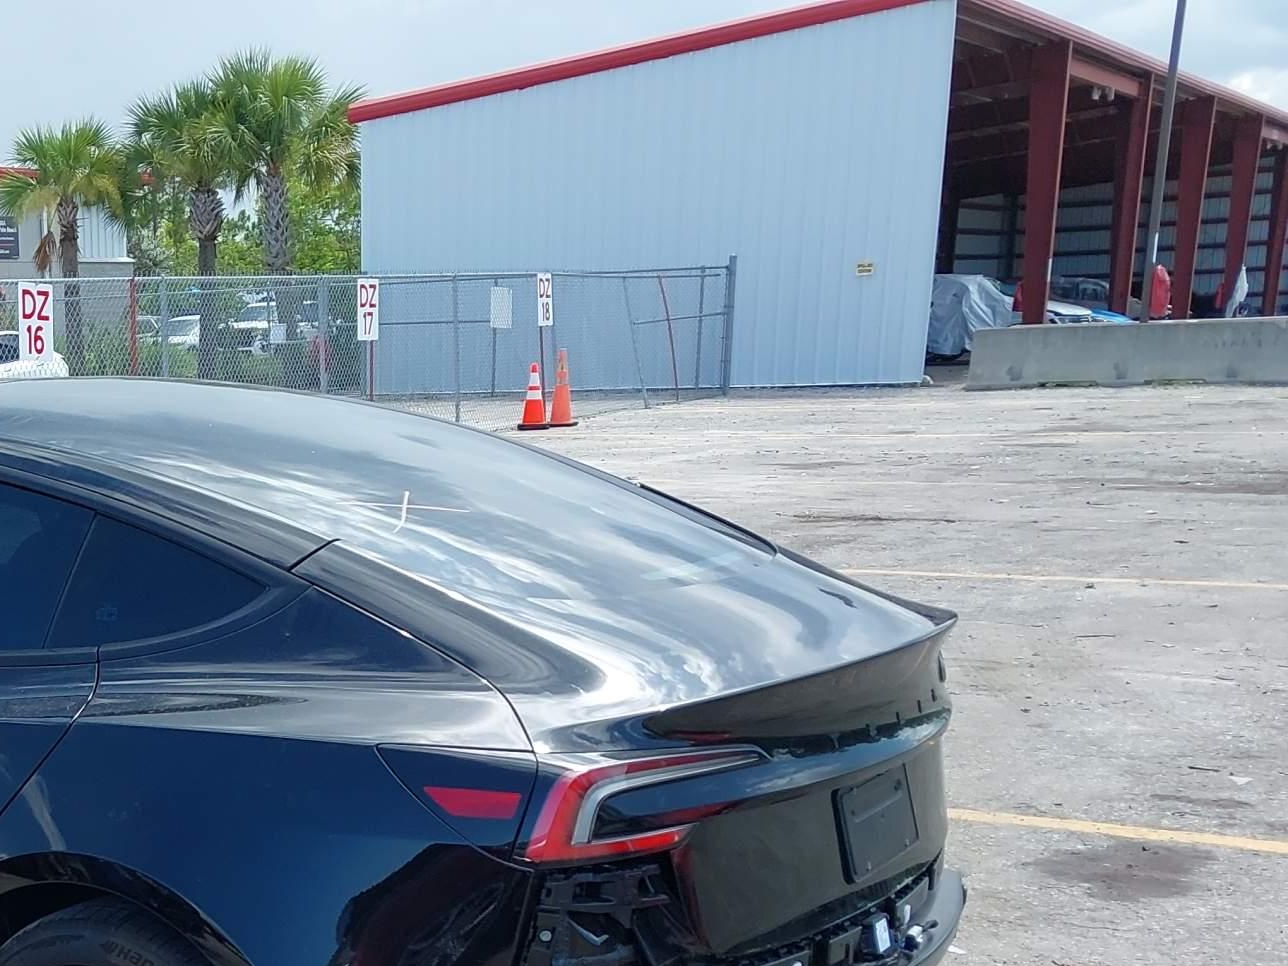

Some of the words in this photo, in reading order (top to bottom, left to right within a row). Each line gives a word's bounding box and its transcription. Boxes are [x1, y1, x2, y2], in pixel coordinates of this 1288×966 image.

[360, 284, 377, 308] DZ
[539, 278, 551, 299] DZ
[22, 288, 50, 321] DZ
[542, 301, 551, 322] 18
[363, 311, 374, 336] 17
[26, 324, 45, 355] 16
